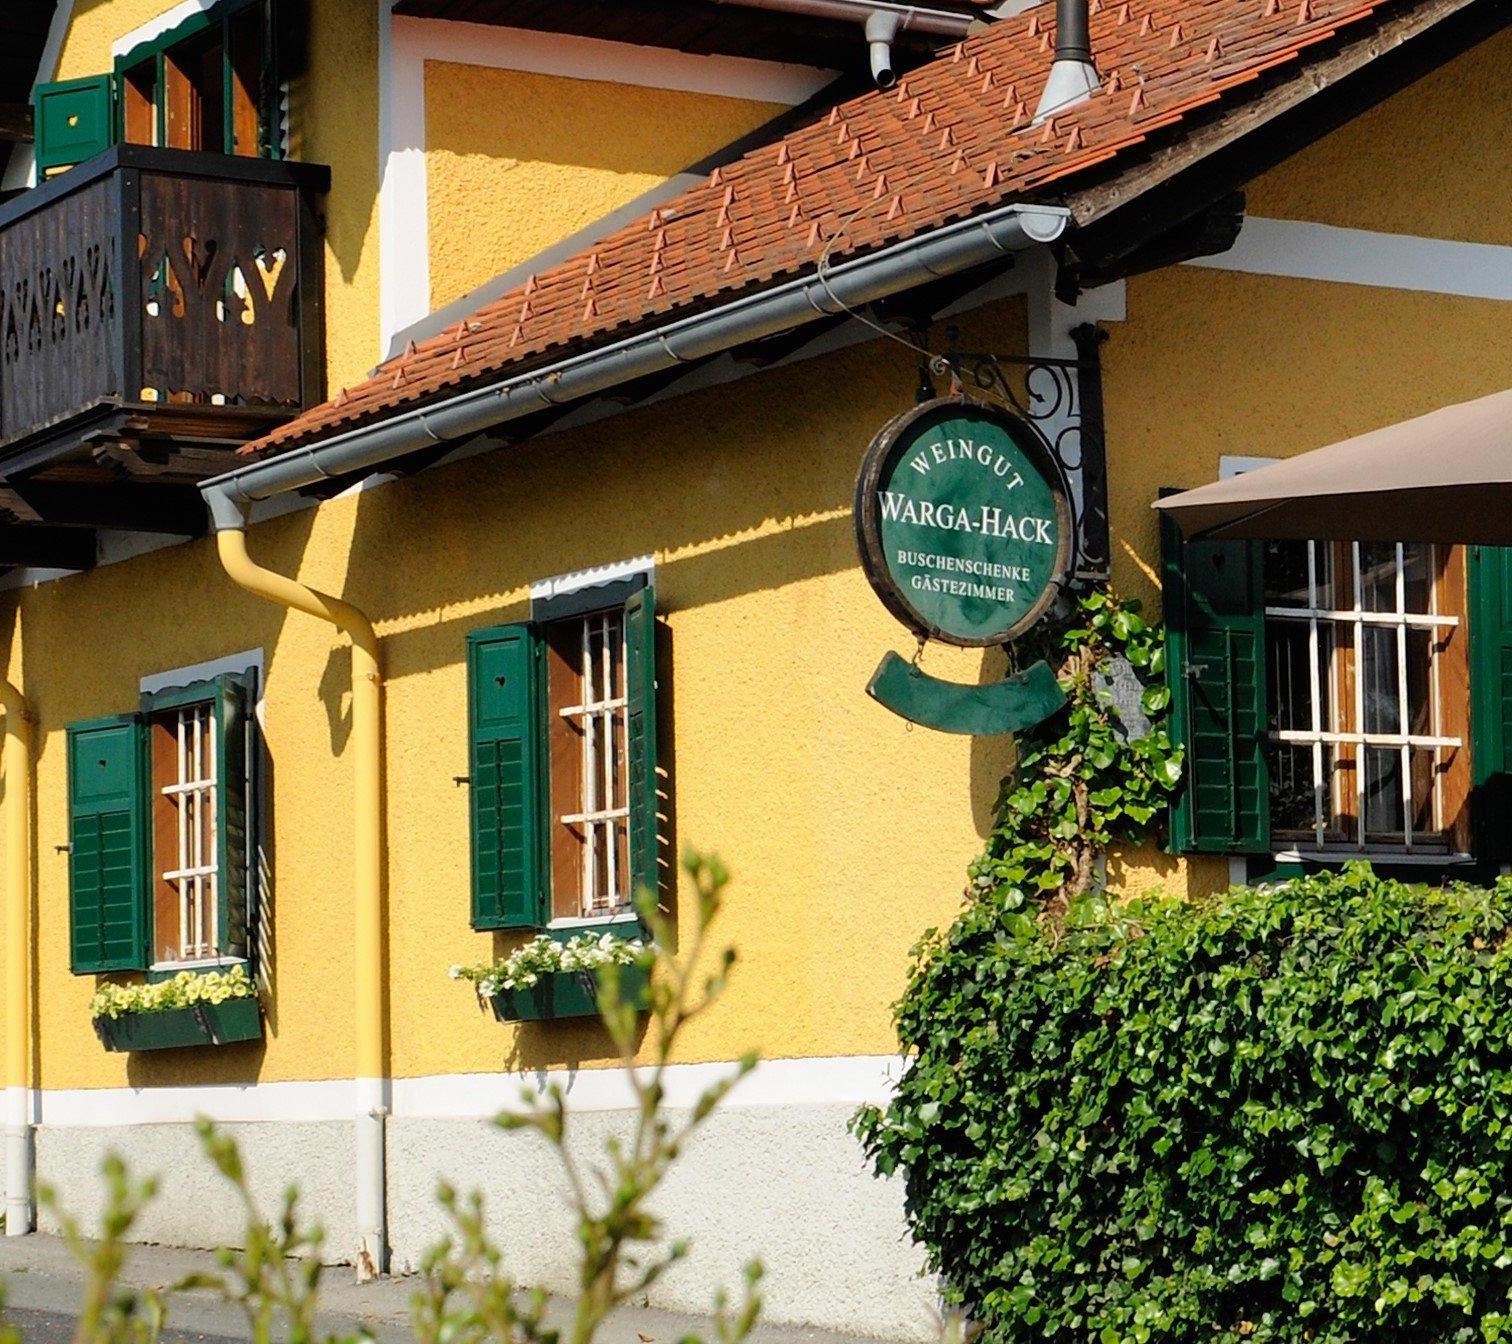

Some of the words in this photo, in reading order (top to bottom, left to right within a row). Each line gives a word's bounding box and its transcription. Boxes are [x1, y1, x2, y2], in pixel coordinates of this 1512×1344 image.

[910, 438, 1024, 491] WEINGUT
[876, 491, 1054, 545] WARGA-HACK
[897, 549, 1031, 582] BUSCHENSCHENKE
[911, 574, 1015, 603] GÄSTEZIMMER
